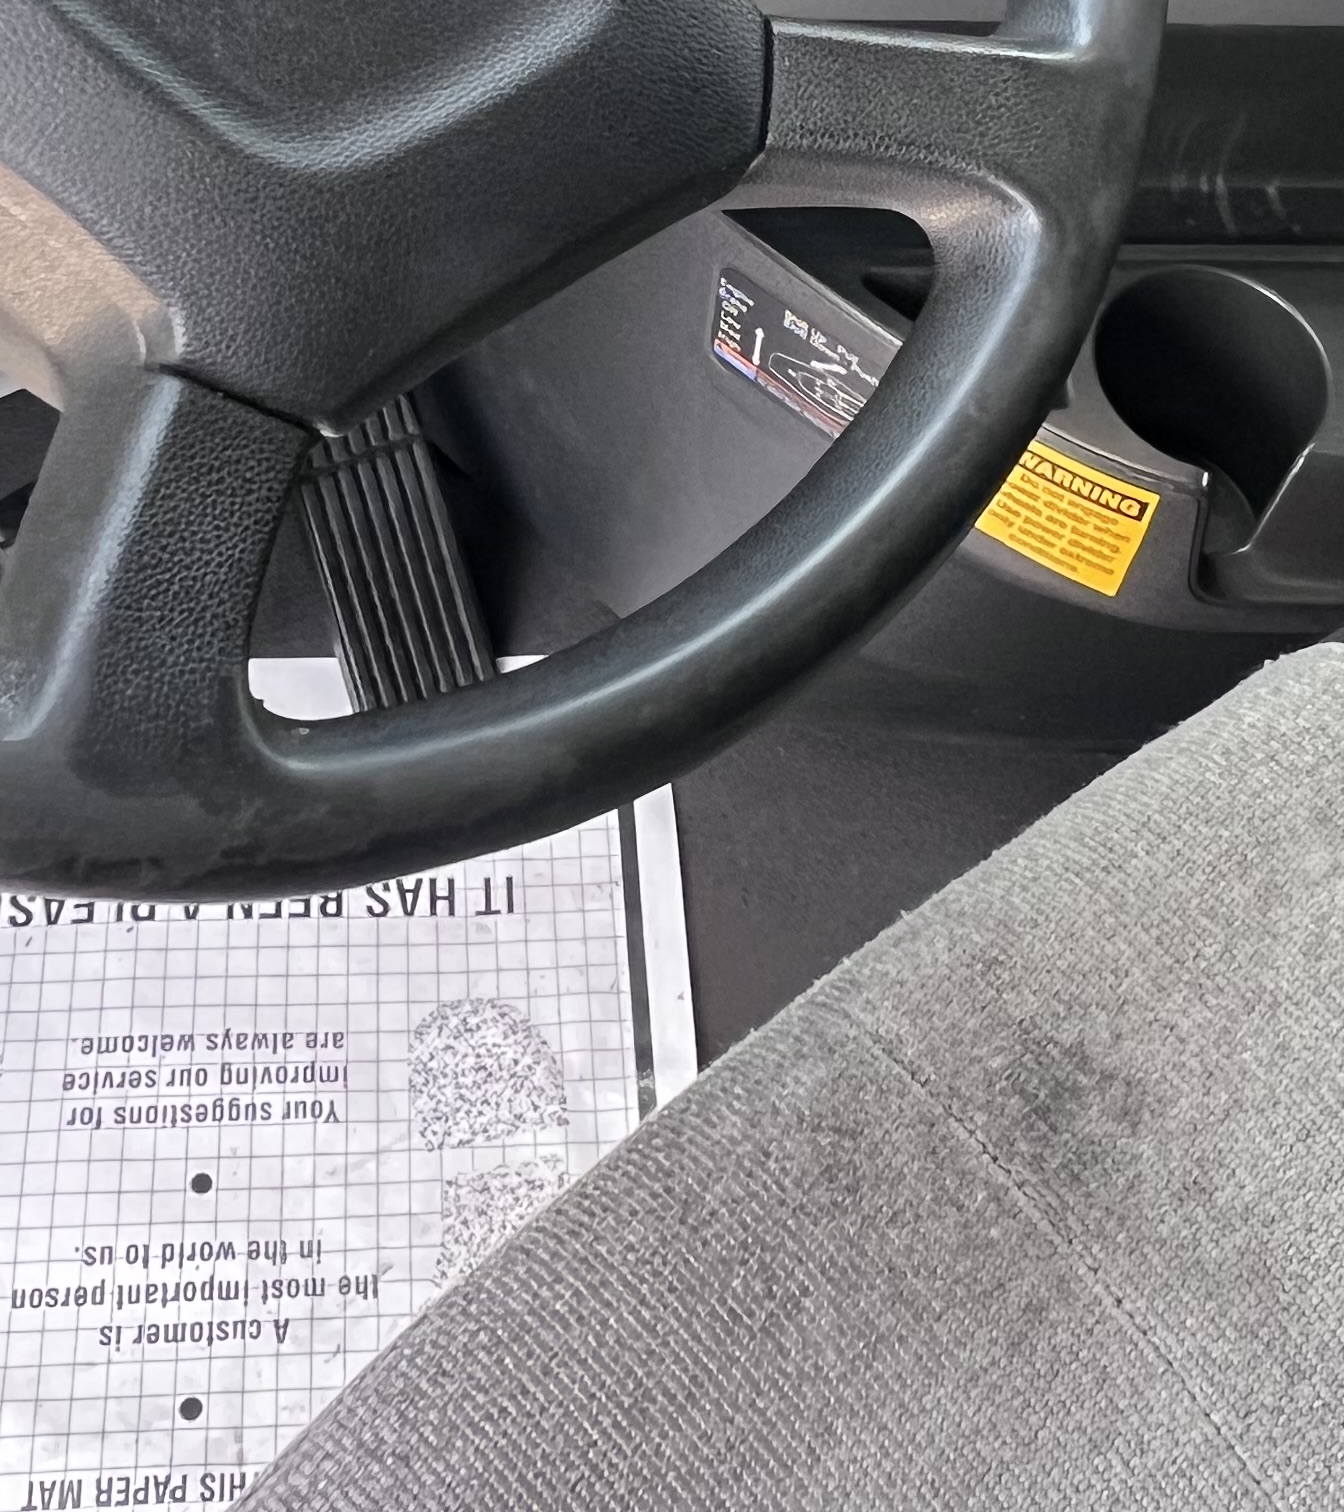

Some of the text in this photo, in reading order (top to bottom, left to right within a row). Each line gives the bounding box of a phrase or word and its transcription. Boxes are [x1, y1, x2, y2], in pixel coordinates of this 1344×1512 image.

[366, 877, 456, 919] HAS
[474, 875, 515, 916] IT
[70, 1028, 345, 1059] are always welcome.
[62, 1061, 349, 1096] improving our service
[66, 1097, 341, 1130] Your suggestions for
[73, 1239, 323, 1269] in the world to us.
[10, 1273, 380, 1311] the most important person
[98, 1317, 291, 1352] A customer is
[20, 1470, 259, 1512] HIS PAPER MAT
